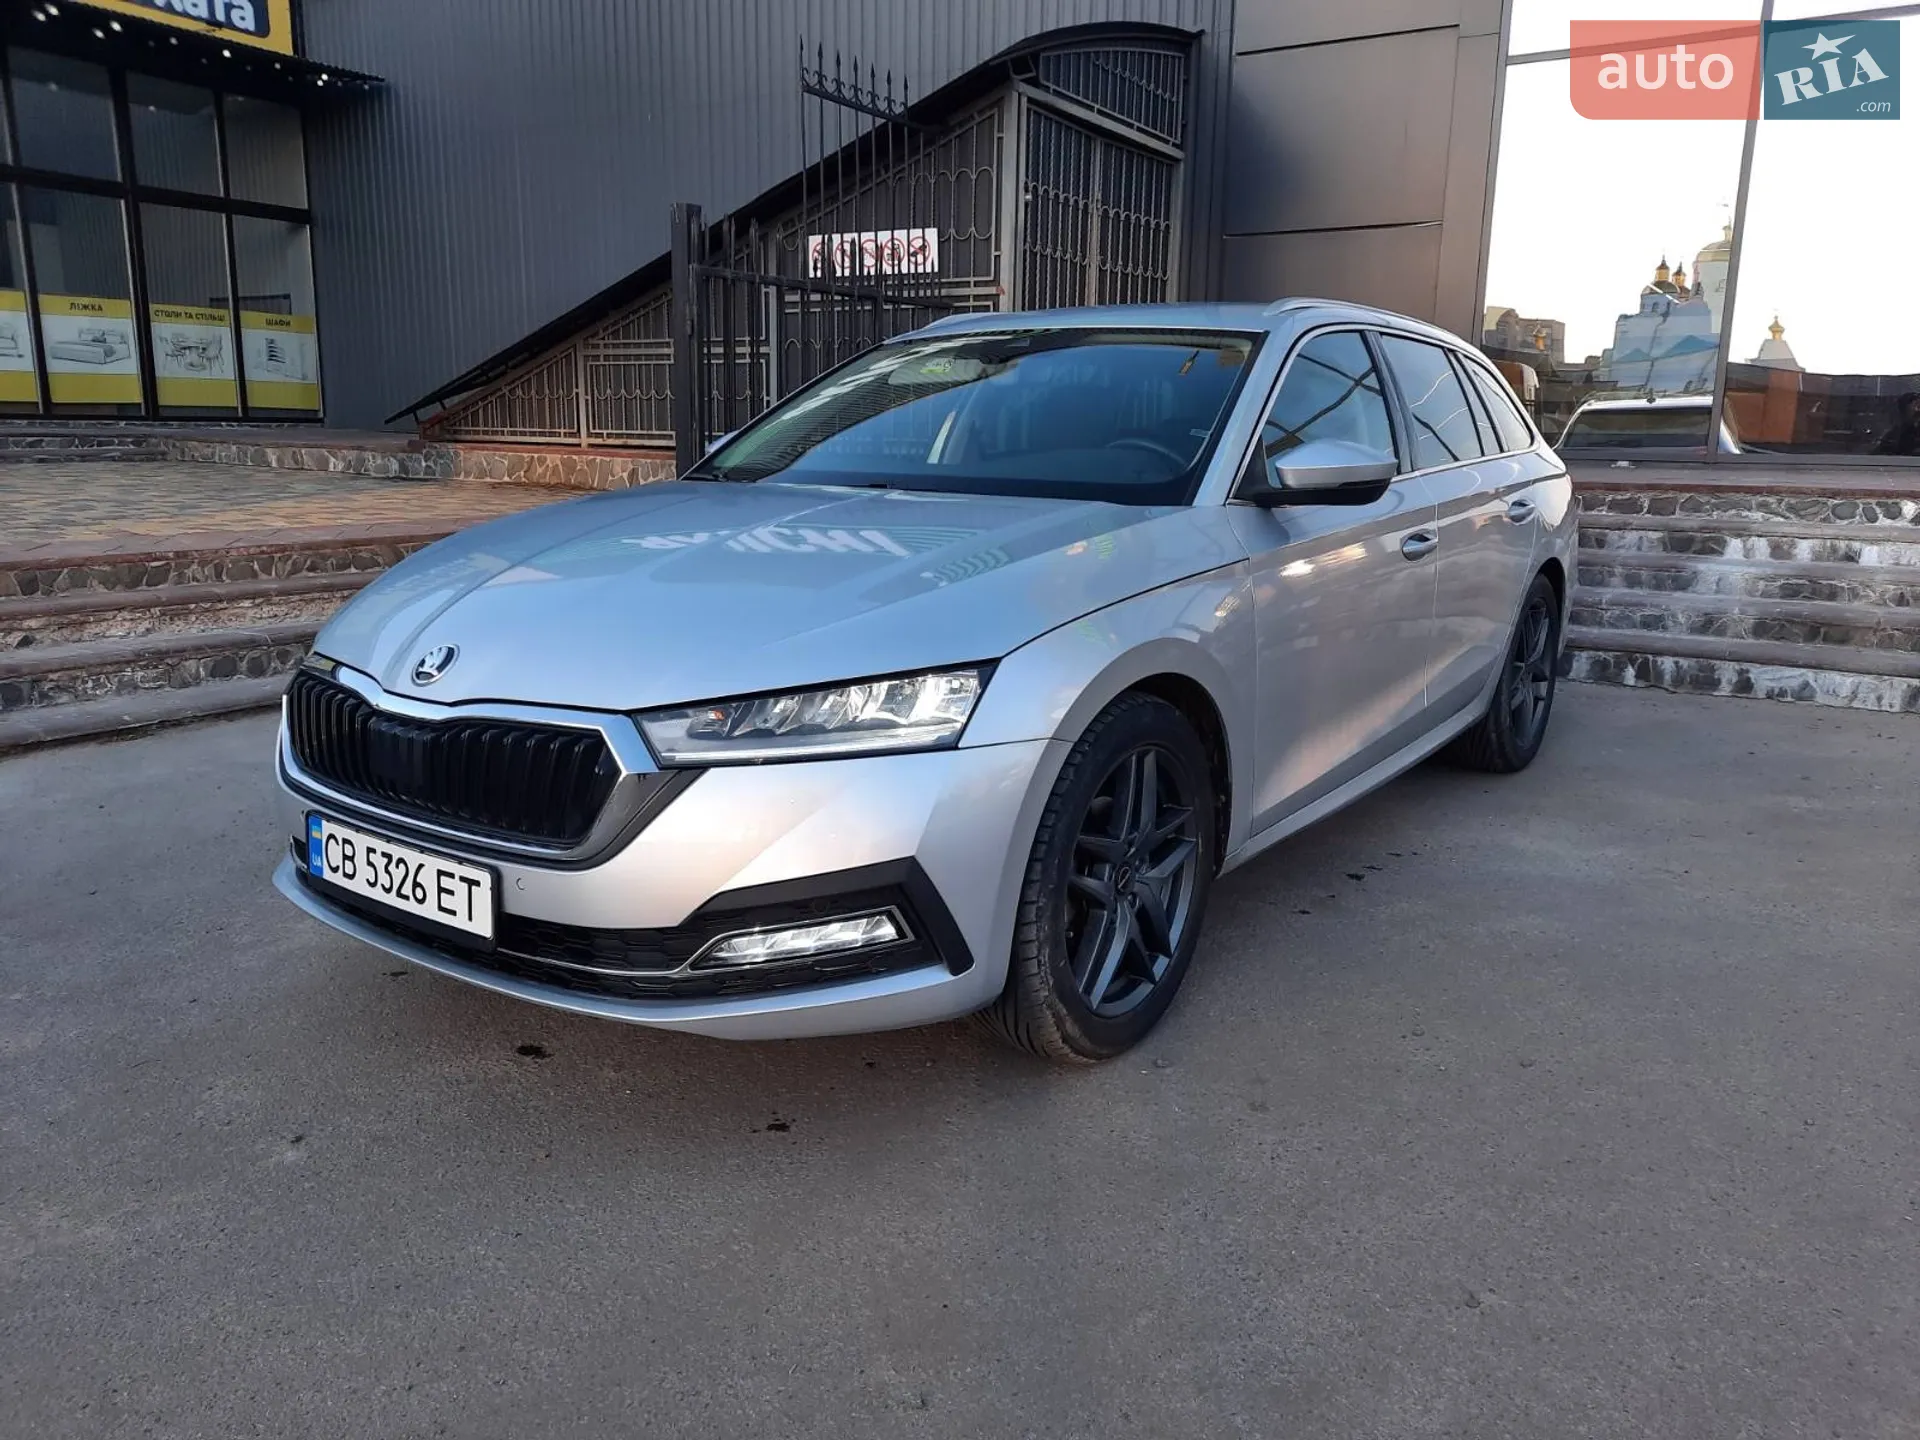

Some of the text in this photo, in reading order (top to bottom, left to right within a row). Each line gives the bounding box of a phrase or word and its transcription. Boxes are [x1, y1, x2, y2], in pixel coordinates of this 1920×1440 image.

[153, 0, 256, 32] ата
[69, 302, 103, 311] ЛІЖКА
[154, 309, 182, 318] СТОЛИ
[184, 311, 194, 319] ТА
[265, 317, 291, 327] ШАФИ
[324, 832, 481, 922] CB 5326 ET
